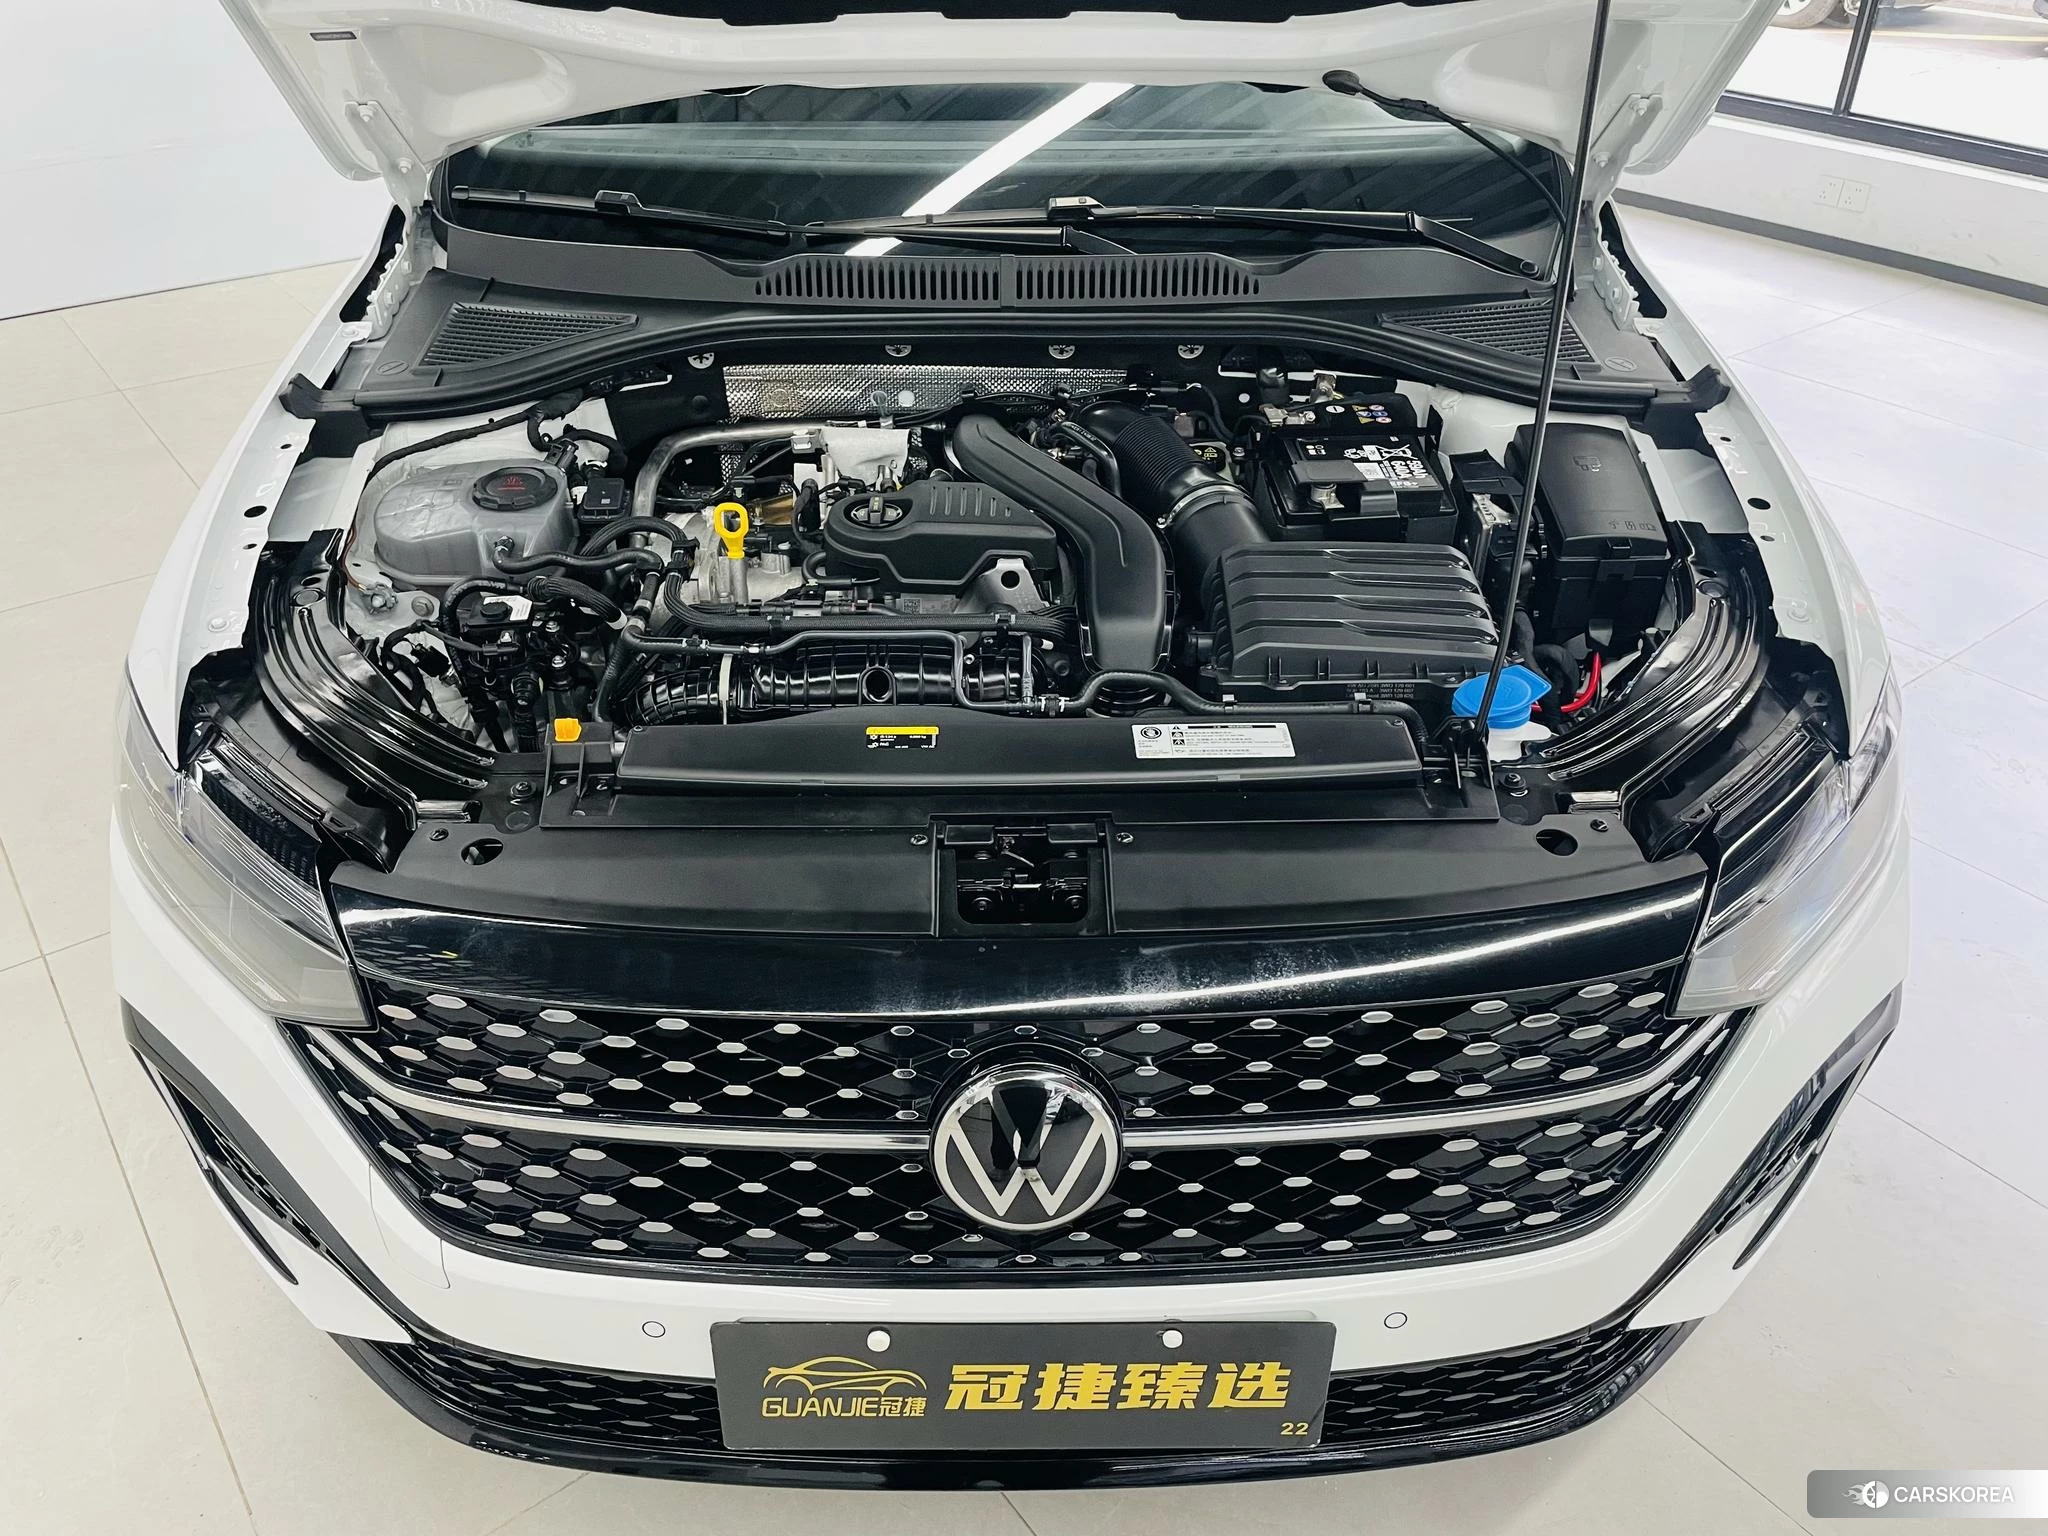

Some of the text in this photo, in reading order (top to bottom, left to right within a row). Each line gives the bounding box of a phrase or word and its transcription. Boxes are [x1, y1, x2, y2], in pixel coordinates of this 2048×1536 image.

[944, 1361, 1292, 1410] 冠捷臻选
[1280, 1422, 1309, 1435] 22
